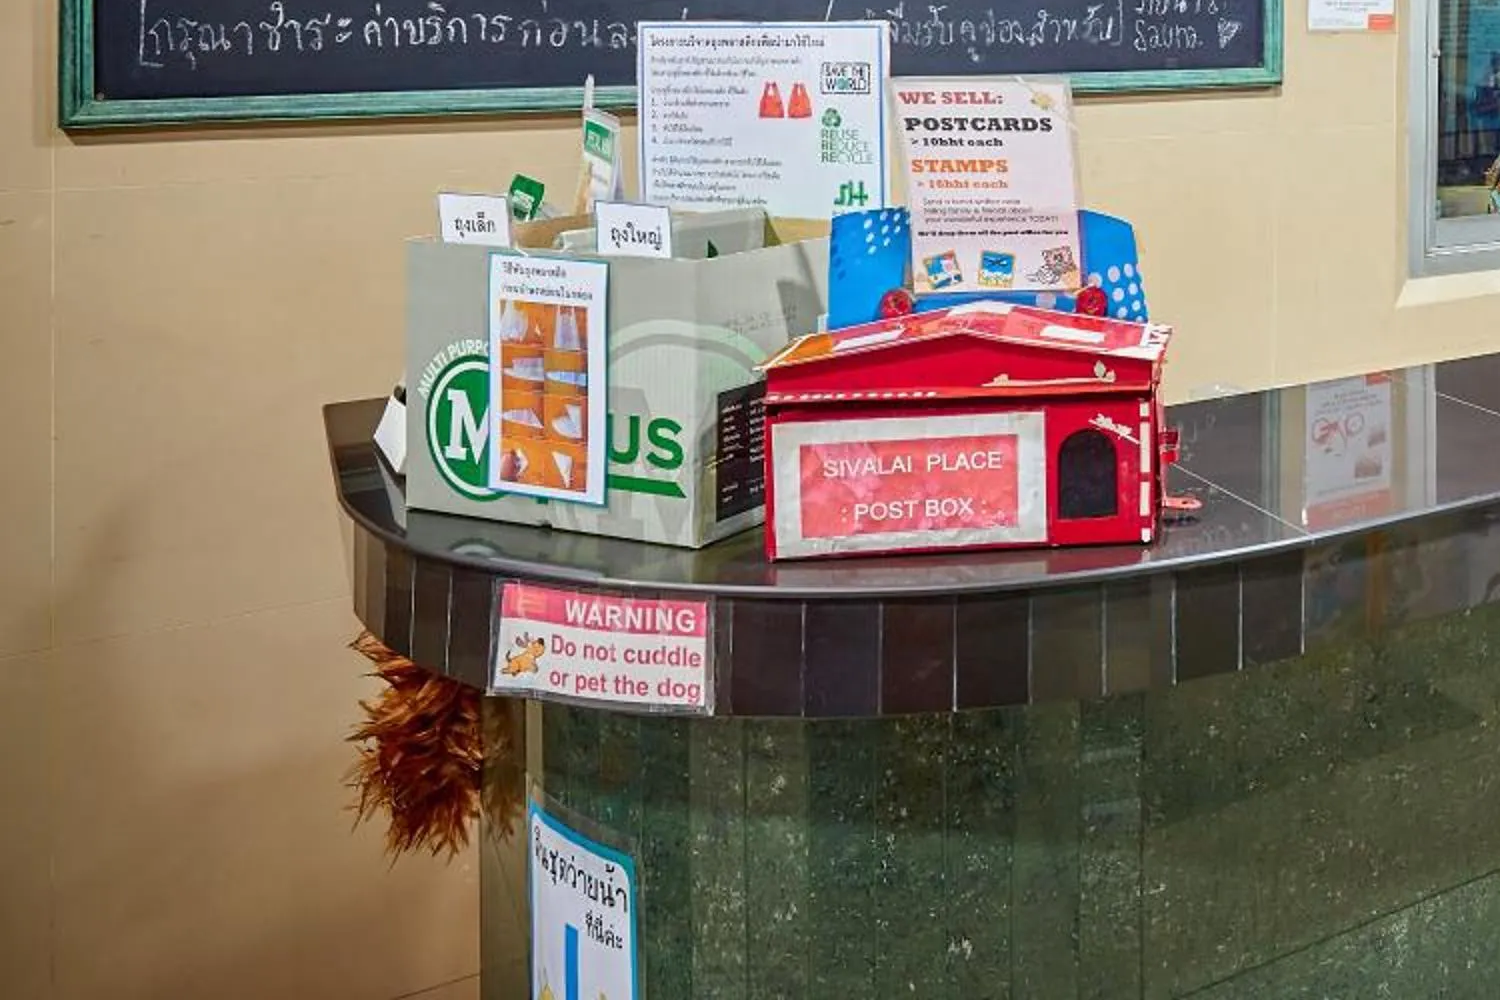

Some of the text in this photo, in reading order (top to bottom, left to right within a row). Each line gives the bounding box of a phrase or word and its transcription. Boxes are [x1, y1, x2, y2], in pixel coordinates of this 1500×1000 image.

[898, 91, 1004, 106] WE SELL:
[820, 129, 860, 141] REUSE
[904, 116, 1053, 132] POSTCARDS
[967, 137, 1004, 148] each
[911, 158, 1009, 174] STAMPS
[972, 179, 1009, 190] each
[454, 211, 497, 238] ถุงเล็ก
[610, 221, 664, 251] ถุงใหญ่
[823, 451, 1003, 479] SIVALAI PLACE
[853, 497, 976, 521] POST BOX
[564, 599, 697, 633] WARNING
[550, 633, 701, 668] Do not cuddle
[549, 669, 701, 704] or pet the dog
